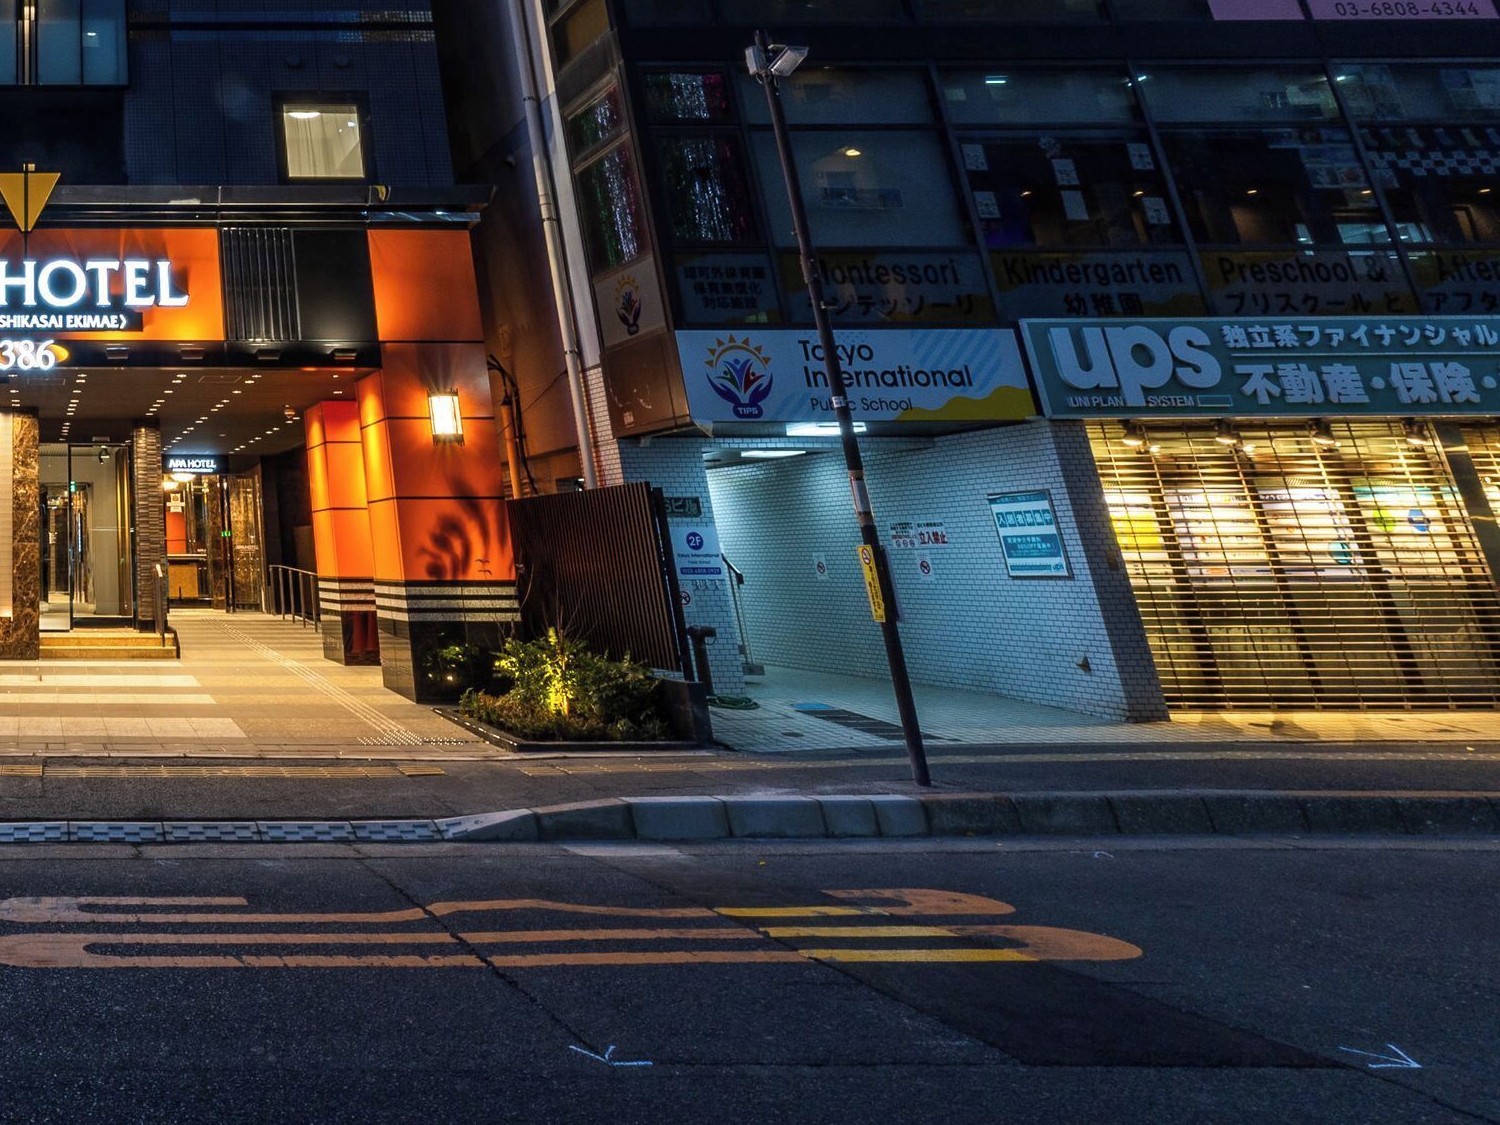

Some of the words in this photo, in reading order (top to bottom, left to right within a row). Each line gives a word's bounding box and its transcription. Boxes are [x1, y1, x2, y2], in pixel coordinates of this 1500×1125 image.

[1335, 2, 1479, 17] 03-6808-4344
[1003, 257, 1183, 286] Kindergarten
[1218, 256, 1358, 283] Preschool
[807, 293, 974, 315] ンテッソーリ
[1063, 292, 1144, 315] 幼稚園
[1221, 324, 1498, 349] 独立系ファイナンシャル
[804, 366, 973, 388] Inernational
[810, 398, 857, 412] Puc
[861, 397, 913, 412] School
[1068, 395, 1090, 407] UNI
[1092, 395, 1124, 407] PLAN
[1147, 394, 1195, 407] SYSTEM
[737, 407, 758, 415] TIPS
[169, 459, 187, 468] APA
[188, 459, 217, 469] HOTEL
[688, 536, 701, 546] 2F
